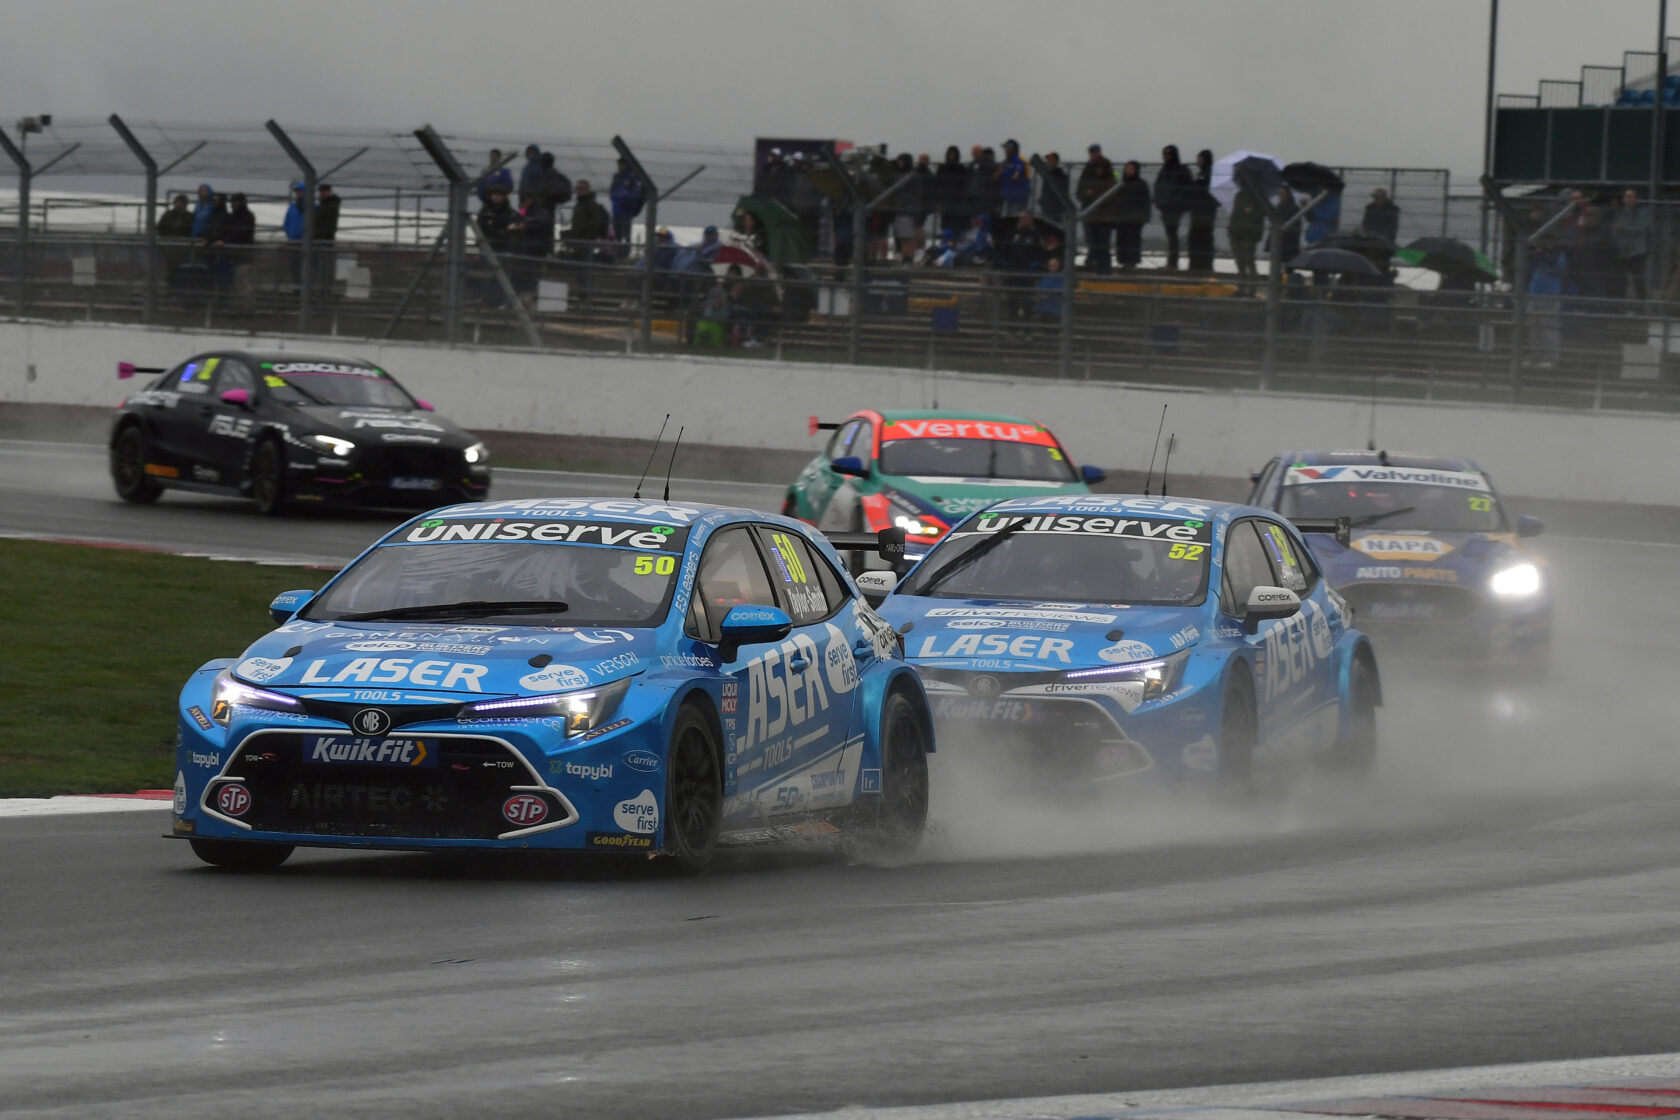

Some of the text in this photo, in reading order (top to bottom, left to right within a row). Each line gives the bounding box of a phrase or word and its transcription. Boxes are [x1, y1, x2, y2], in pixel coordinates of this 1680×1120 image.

[1352, 469, 1480, 488] Valvoline
[1067, 505, 1122, 513] TOOLS
[1468, 497, 1491, 512] 27
[522, 509, 592, 518] TOOLS
[1168, 543, 1204, 561] 52
[1366, 539, 1440, 552] NAPA
[633, 556, 676, 576] 50
[682, 551, 699, 596] Leaders
[1356, 566, 1457, 582] AUTO PARTS
[827, 643, 850, 668] serve
[919, 634, 1075, 663] LASER
[1104, 643, 1144, 656] serve
[250, 658, 282, 672] serve
[971, 659, 1012, 669] TOOLS
[299, 657, 489, 693] LASER
[528, 668, 575, 683] serve
[353, 690, 402, 701] TOOLS
[722, 683, 738, 697] LIQUI
[721, 697, 738, 713] MOLY
[457, 716, 561, 732] ecommerce
[192, 751, 220, 768] tapybl
[627, 753, 658, 768] Carrier
[763, 736, 793, 770] TOOLS
[565, 762, 613, 780] tapybl
[221, 787, 248, 811] STP
[507, 798, 544, 823] STP
[622, 803, 654, 817] serve
[593, 834, 651, 847] GOODYEAR
